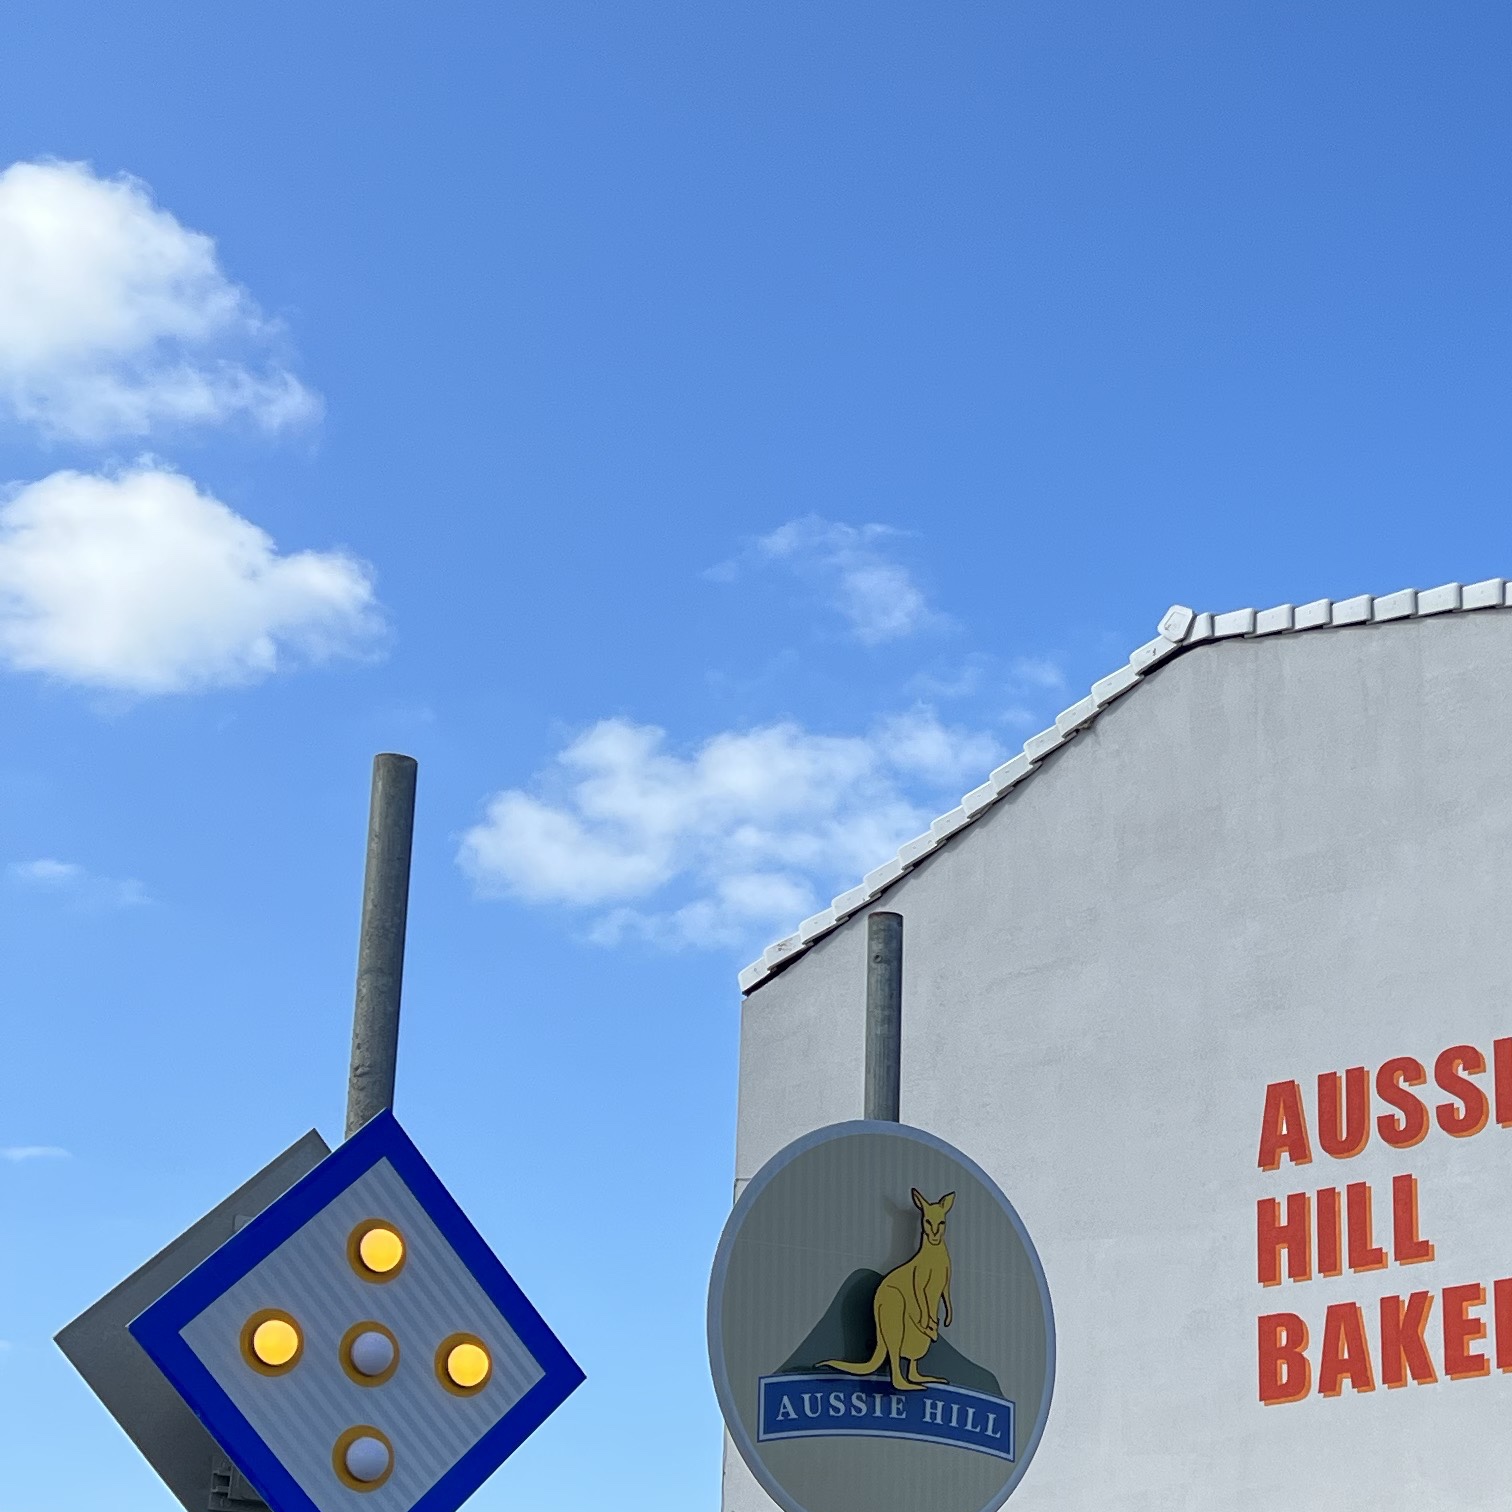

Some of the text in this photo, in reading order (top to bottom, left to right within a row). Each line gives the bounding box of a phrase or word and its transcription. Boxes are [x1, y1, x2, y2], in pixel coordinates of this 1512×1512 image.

[1256, 1173, 1435, 1288] HILL
[776, 1392, 1002, 1438] AUSSIE HILL
